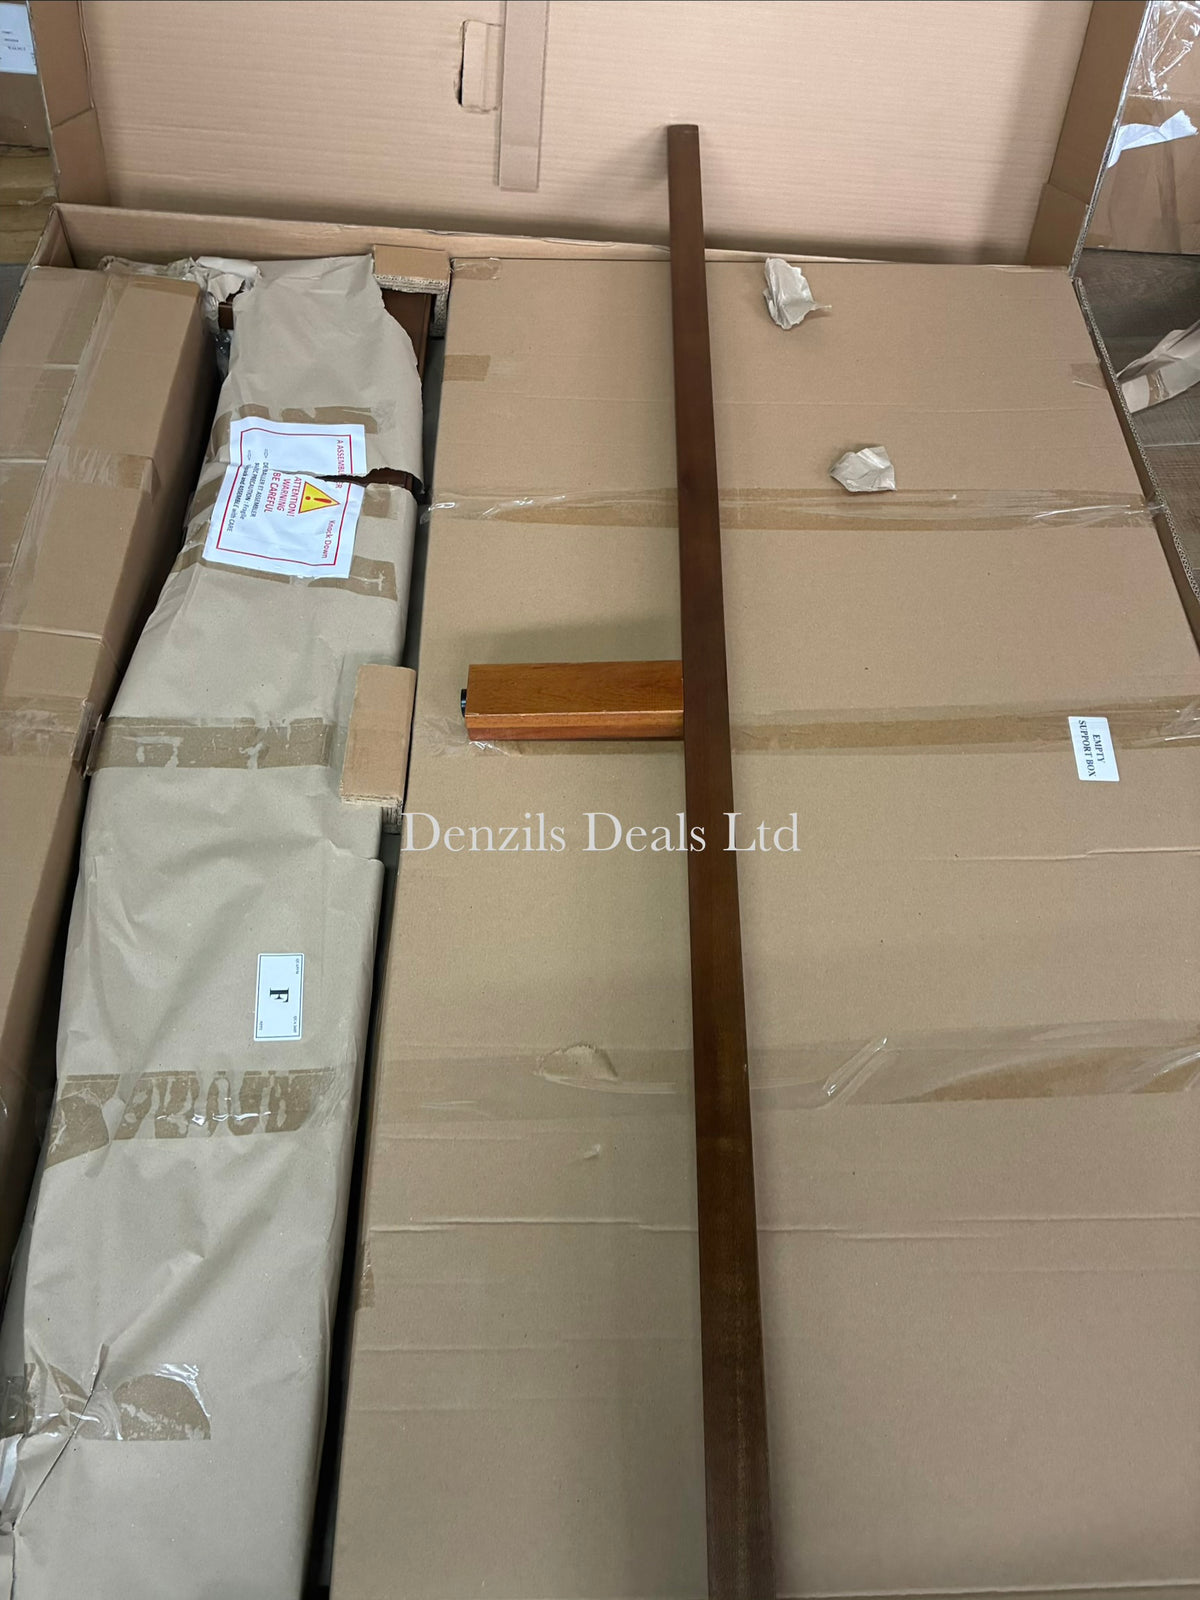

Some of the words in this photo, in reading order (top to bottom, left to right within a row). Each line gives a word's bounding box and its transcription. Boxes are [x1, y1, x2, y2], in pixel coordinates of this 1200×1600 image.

[272, 472, 282, 482] BE
[250, 491, 262, 518] ASSEMBLER
[264, 482, 279, 513] CAREFUL
[277, 478, 291, 512] WARNING
[287, 476, 302, 517] ATTENTION!
[227, 518, 236, 532] CARE
[326, 519, 336, 538] Knock
[321, 539, 332, 559] Down
[1079, 719, 1093, 758] SUPPORT
[1086, 759, 1097, 777] BOX
[1093, 734, 1106, 763] EMPTY
[269, 987, 290, 1003] F
